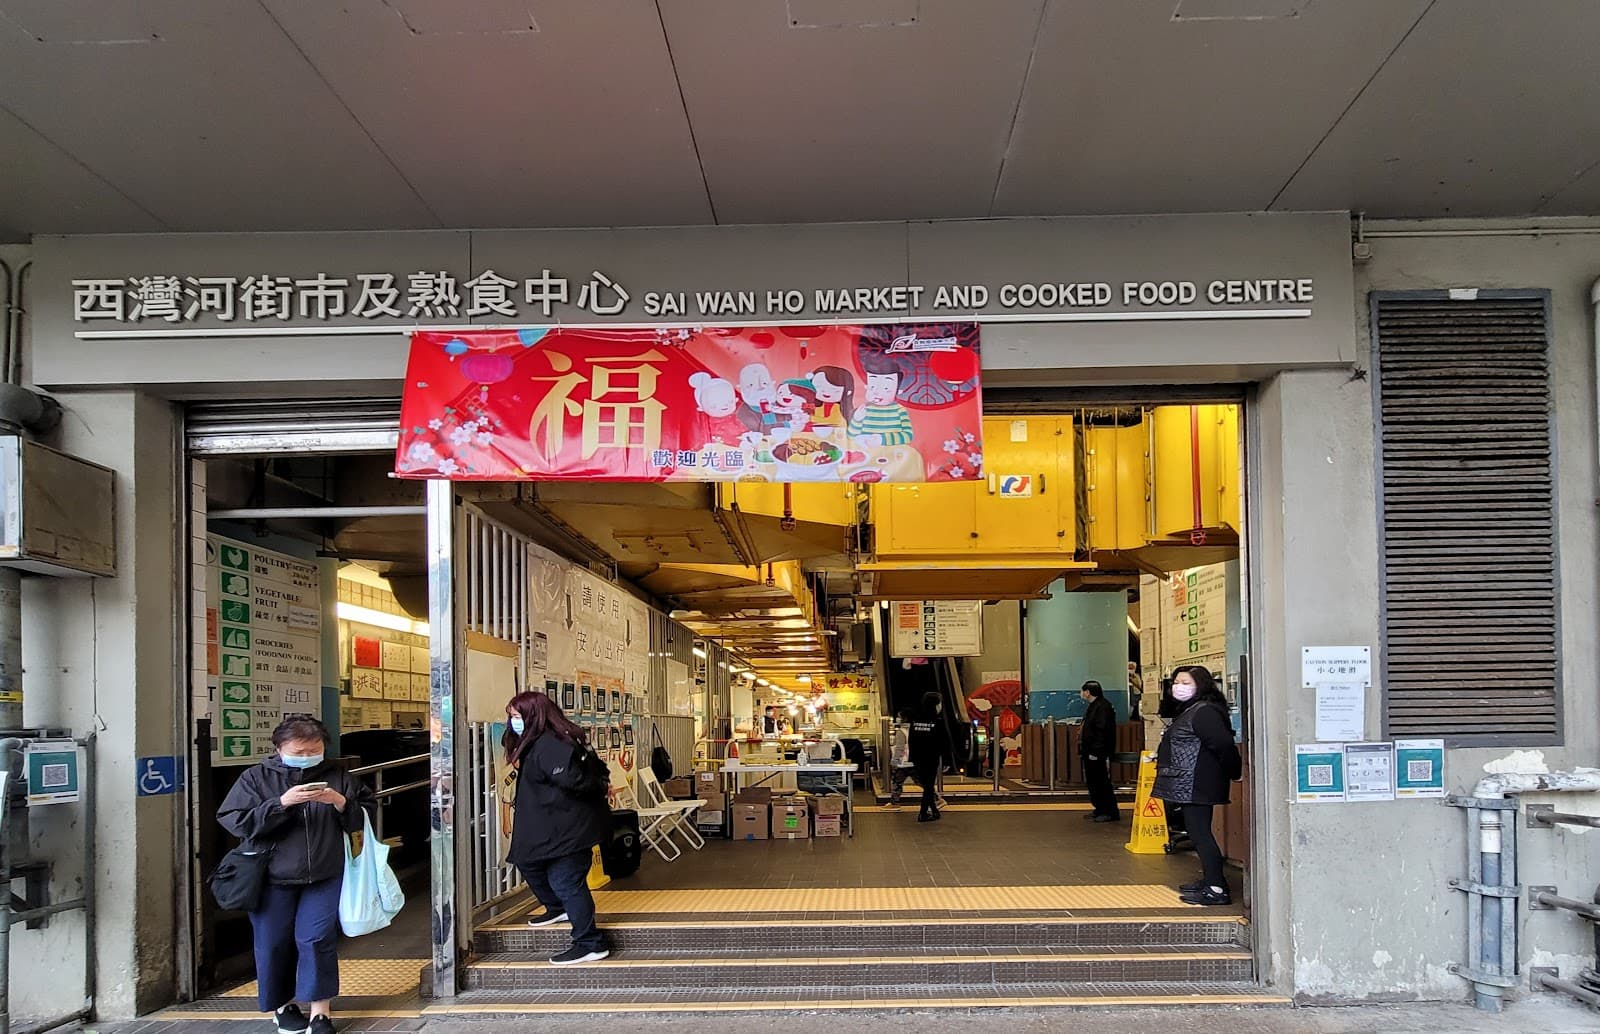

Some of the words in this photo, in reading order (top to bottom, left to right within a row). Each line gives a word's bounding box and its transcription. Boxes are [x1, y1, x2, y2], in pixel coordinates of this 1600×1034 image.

[71, 269, 630, 321] 西灣河街市及熟食中心
[644, 292, 686, 315] SAI
[696, 291, 755, 314] WAN
[766, 290, 804, 313] HO
[815, 286, 924, 311] MARKET
[933, 285, 989, 308] AND
[1000, 283, 1112, 307] COOKED
[1123, 281, 1197, 305] FOOD
[1207, 279, 1314, 303] CENTRE
[529, 349, 669, 463] 福
[653, 451, 744, 467] 歡迎光臨
[254, 553, 292, 571] POULTRY
[255, 597, 279, 609] FRUIT
[583, 584, 619, 620] 請使用
[255, 638, 295, 650] GROCERIES
[577, 630, 625, 662] 安心出行
[1317, 666, 1357, 674] 小心地滑
[256, 684, 273, 692] FISH
[284, 688, 309, 704] 出口
[256, 710, 279, 718] MEAT
